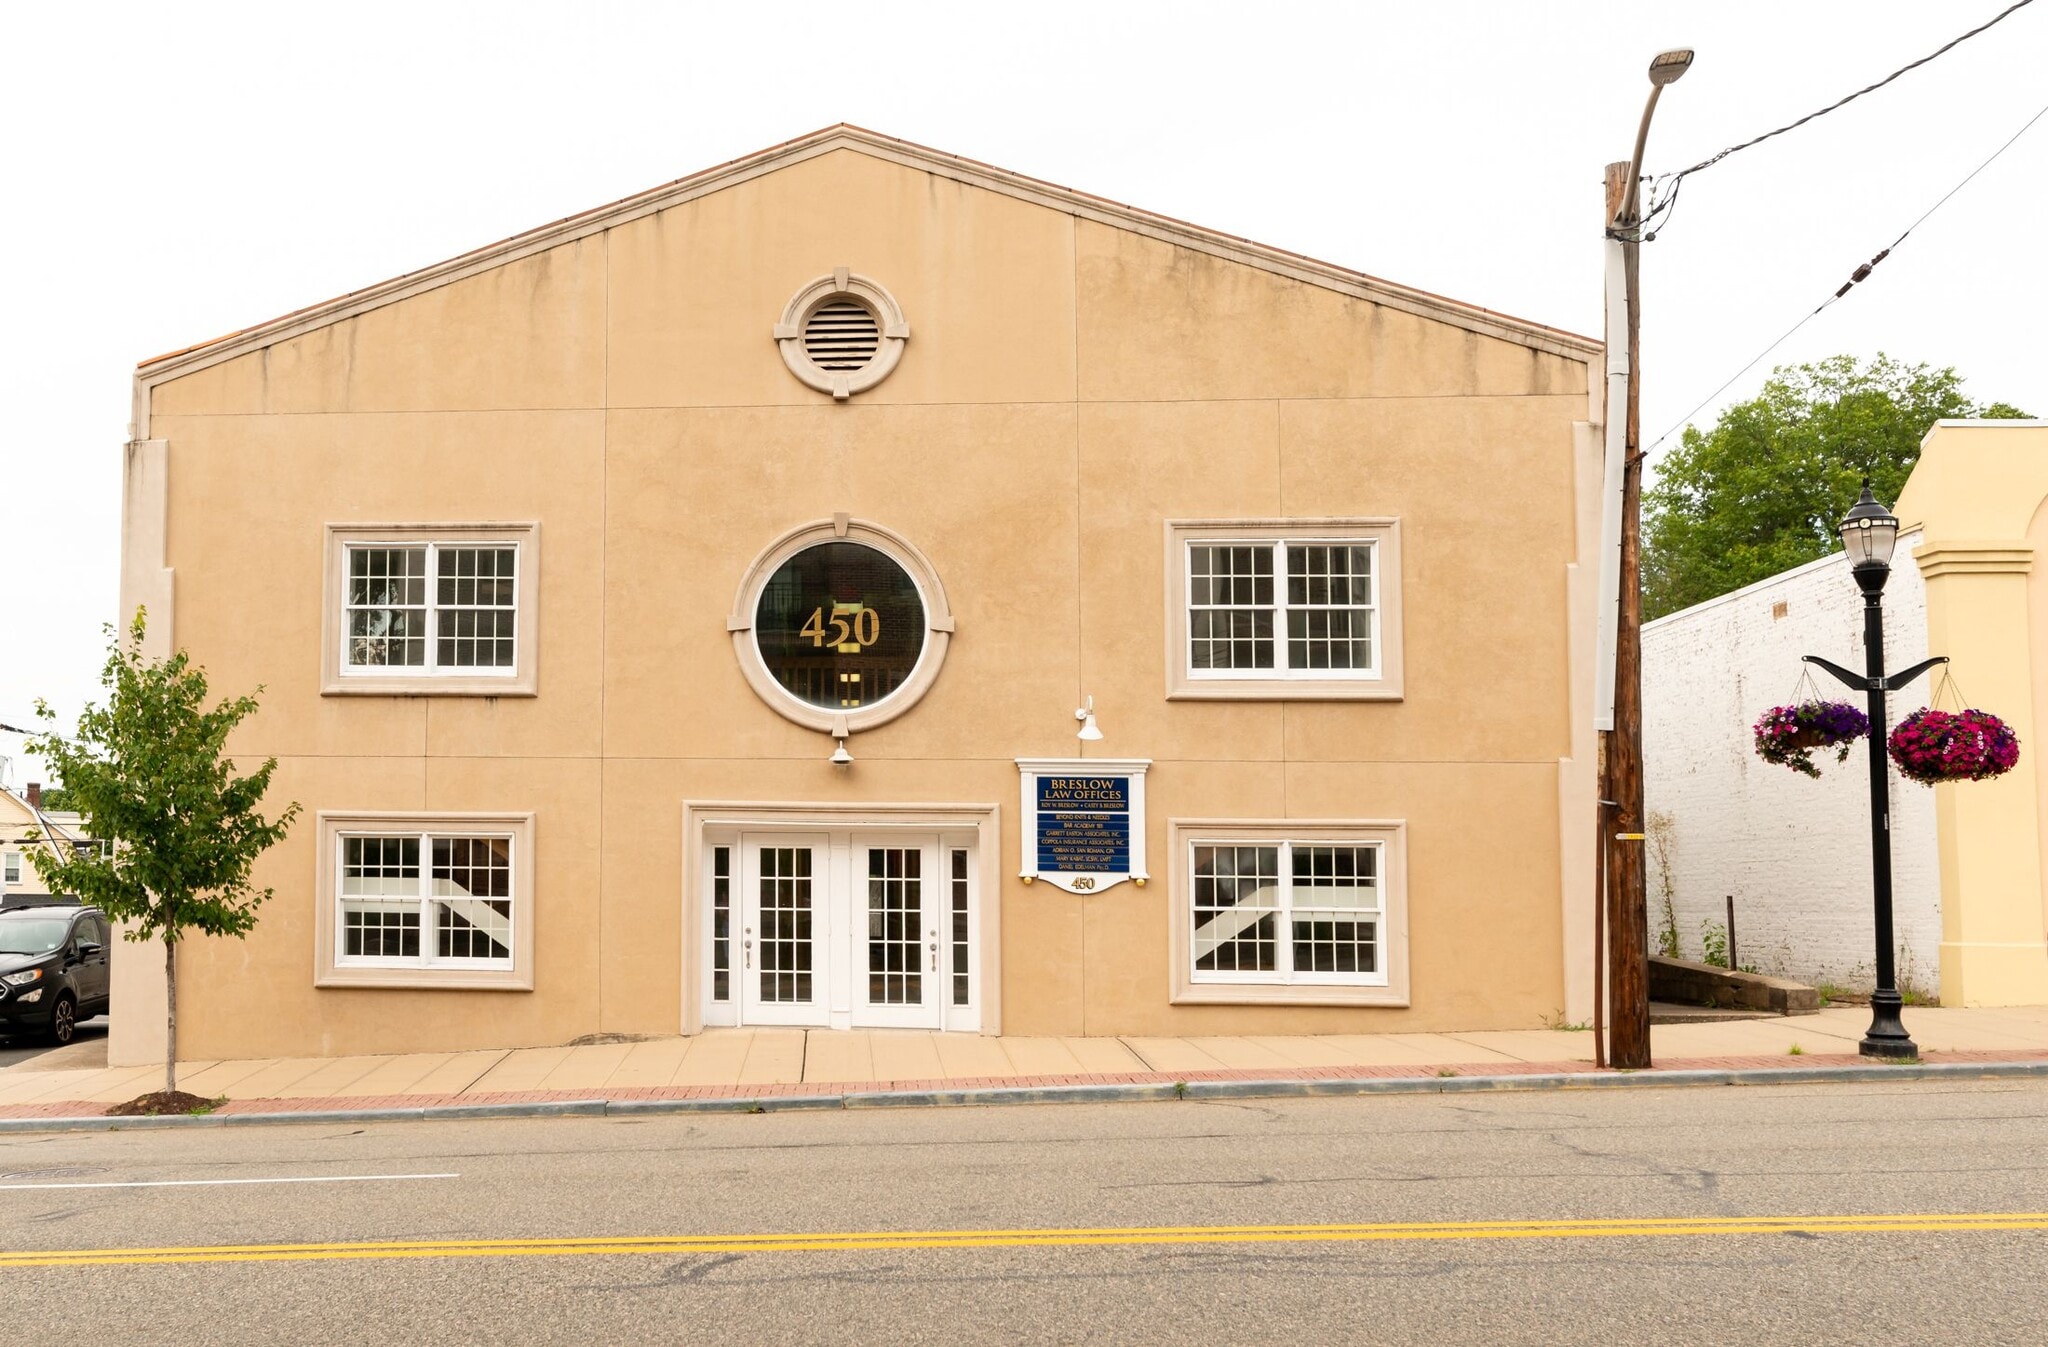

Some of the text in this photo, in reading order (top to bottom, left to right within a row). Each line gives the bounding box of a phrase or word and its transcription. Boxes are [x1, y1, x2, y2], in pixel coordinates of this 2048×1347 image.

[799, 606, 880, 648] 450
[1051, 779, 1114, 789] BRESLOW
[1045, 790, 1121, 799] LAW OFFICES
[1071, 877, 1096, 890] 450
